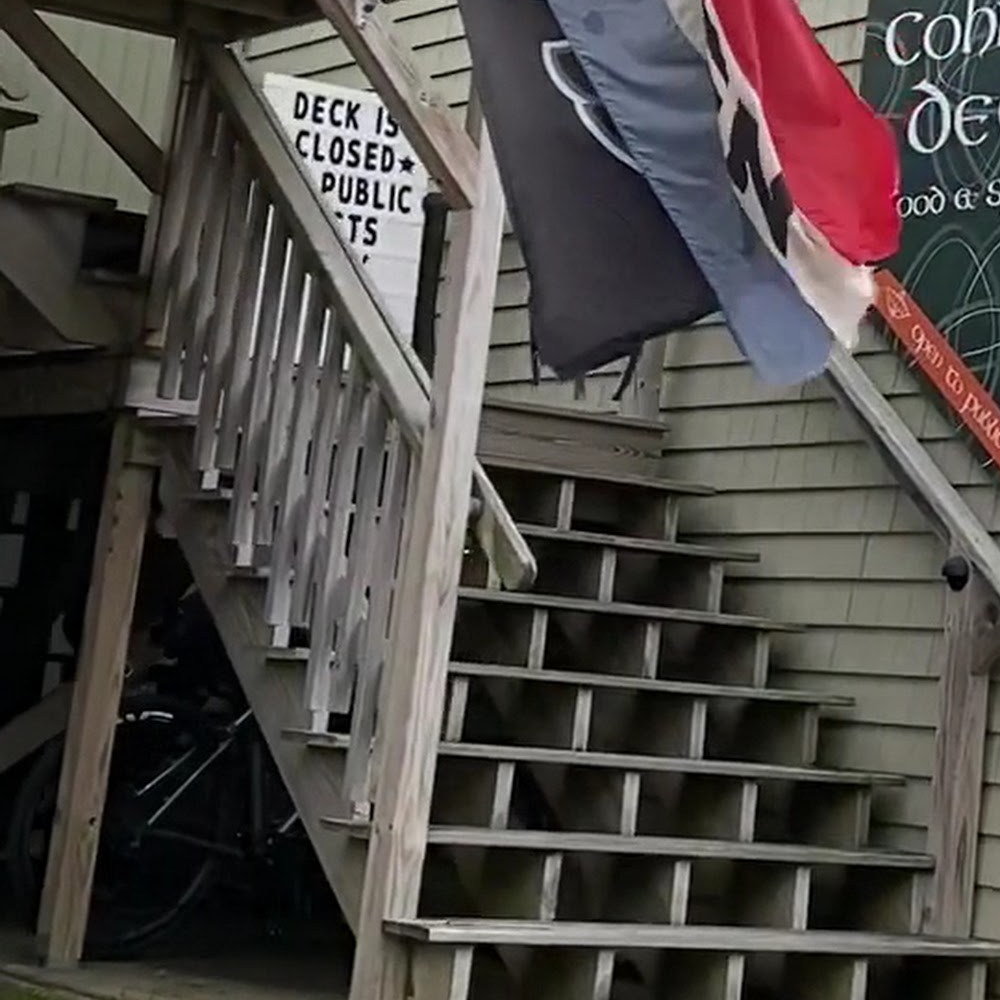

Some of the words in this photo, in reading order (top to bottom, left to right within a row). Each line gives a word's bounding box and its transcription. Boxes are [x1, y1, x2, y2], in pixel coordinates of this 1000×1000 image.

[293, 91, 361, 130] DECK
[375, 106, 400, 138] IS
[295, 130, 396, 173] CLOSED
[321, 172, 413, 214] PUBLIC
[896, 186, 946, 218] ood
